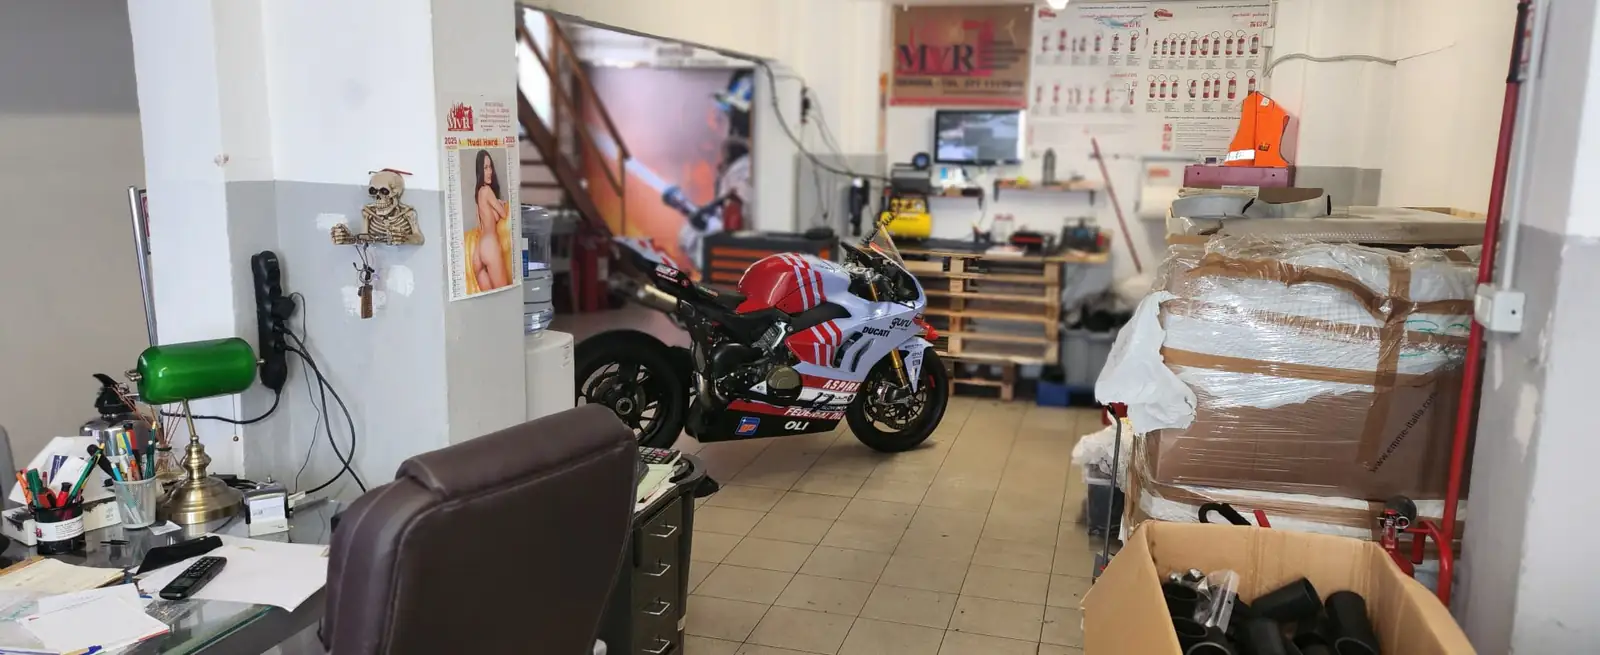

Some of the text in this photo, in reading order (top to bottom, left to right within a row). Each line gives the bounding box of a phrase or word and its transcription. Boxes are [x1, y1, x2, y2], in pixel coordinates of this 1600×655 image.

[896, 44, 974, 71] MVR
[444, 137, 458, 145] 2025
[889, 317, 913, 330] guru
[862, 326, 891, 338] DUCATI
[822, 379, 861, 393] ASPIRA
[784, 421, 810, 431] OLI
